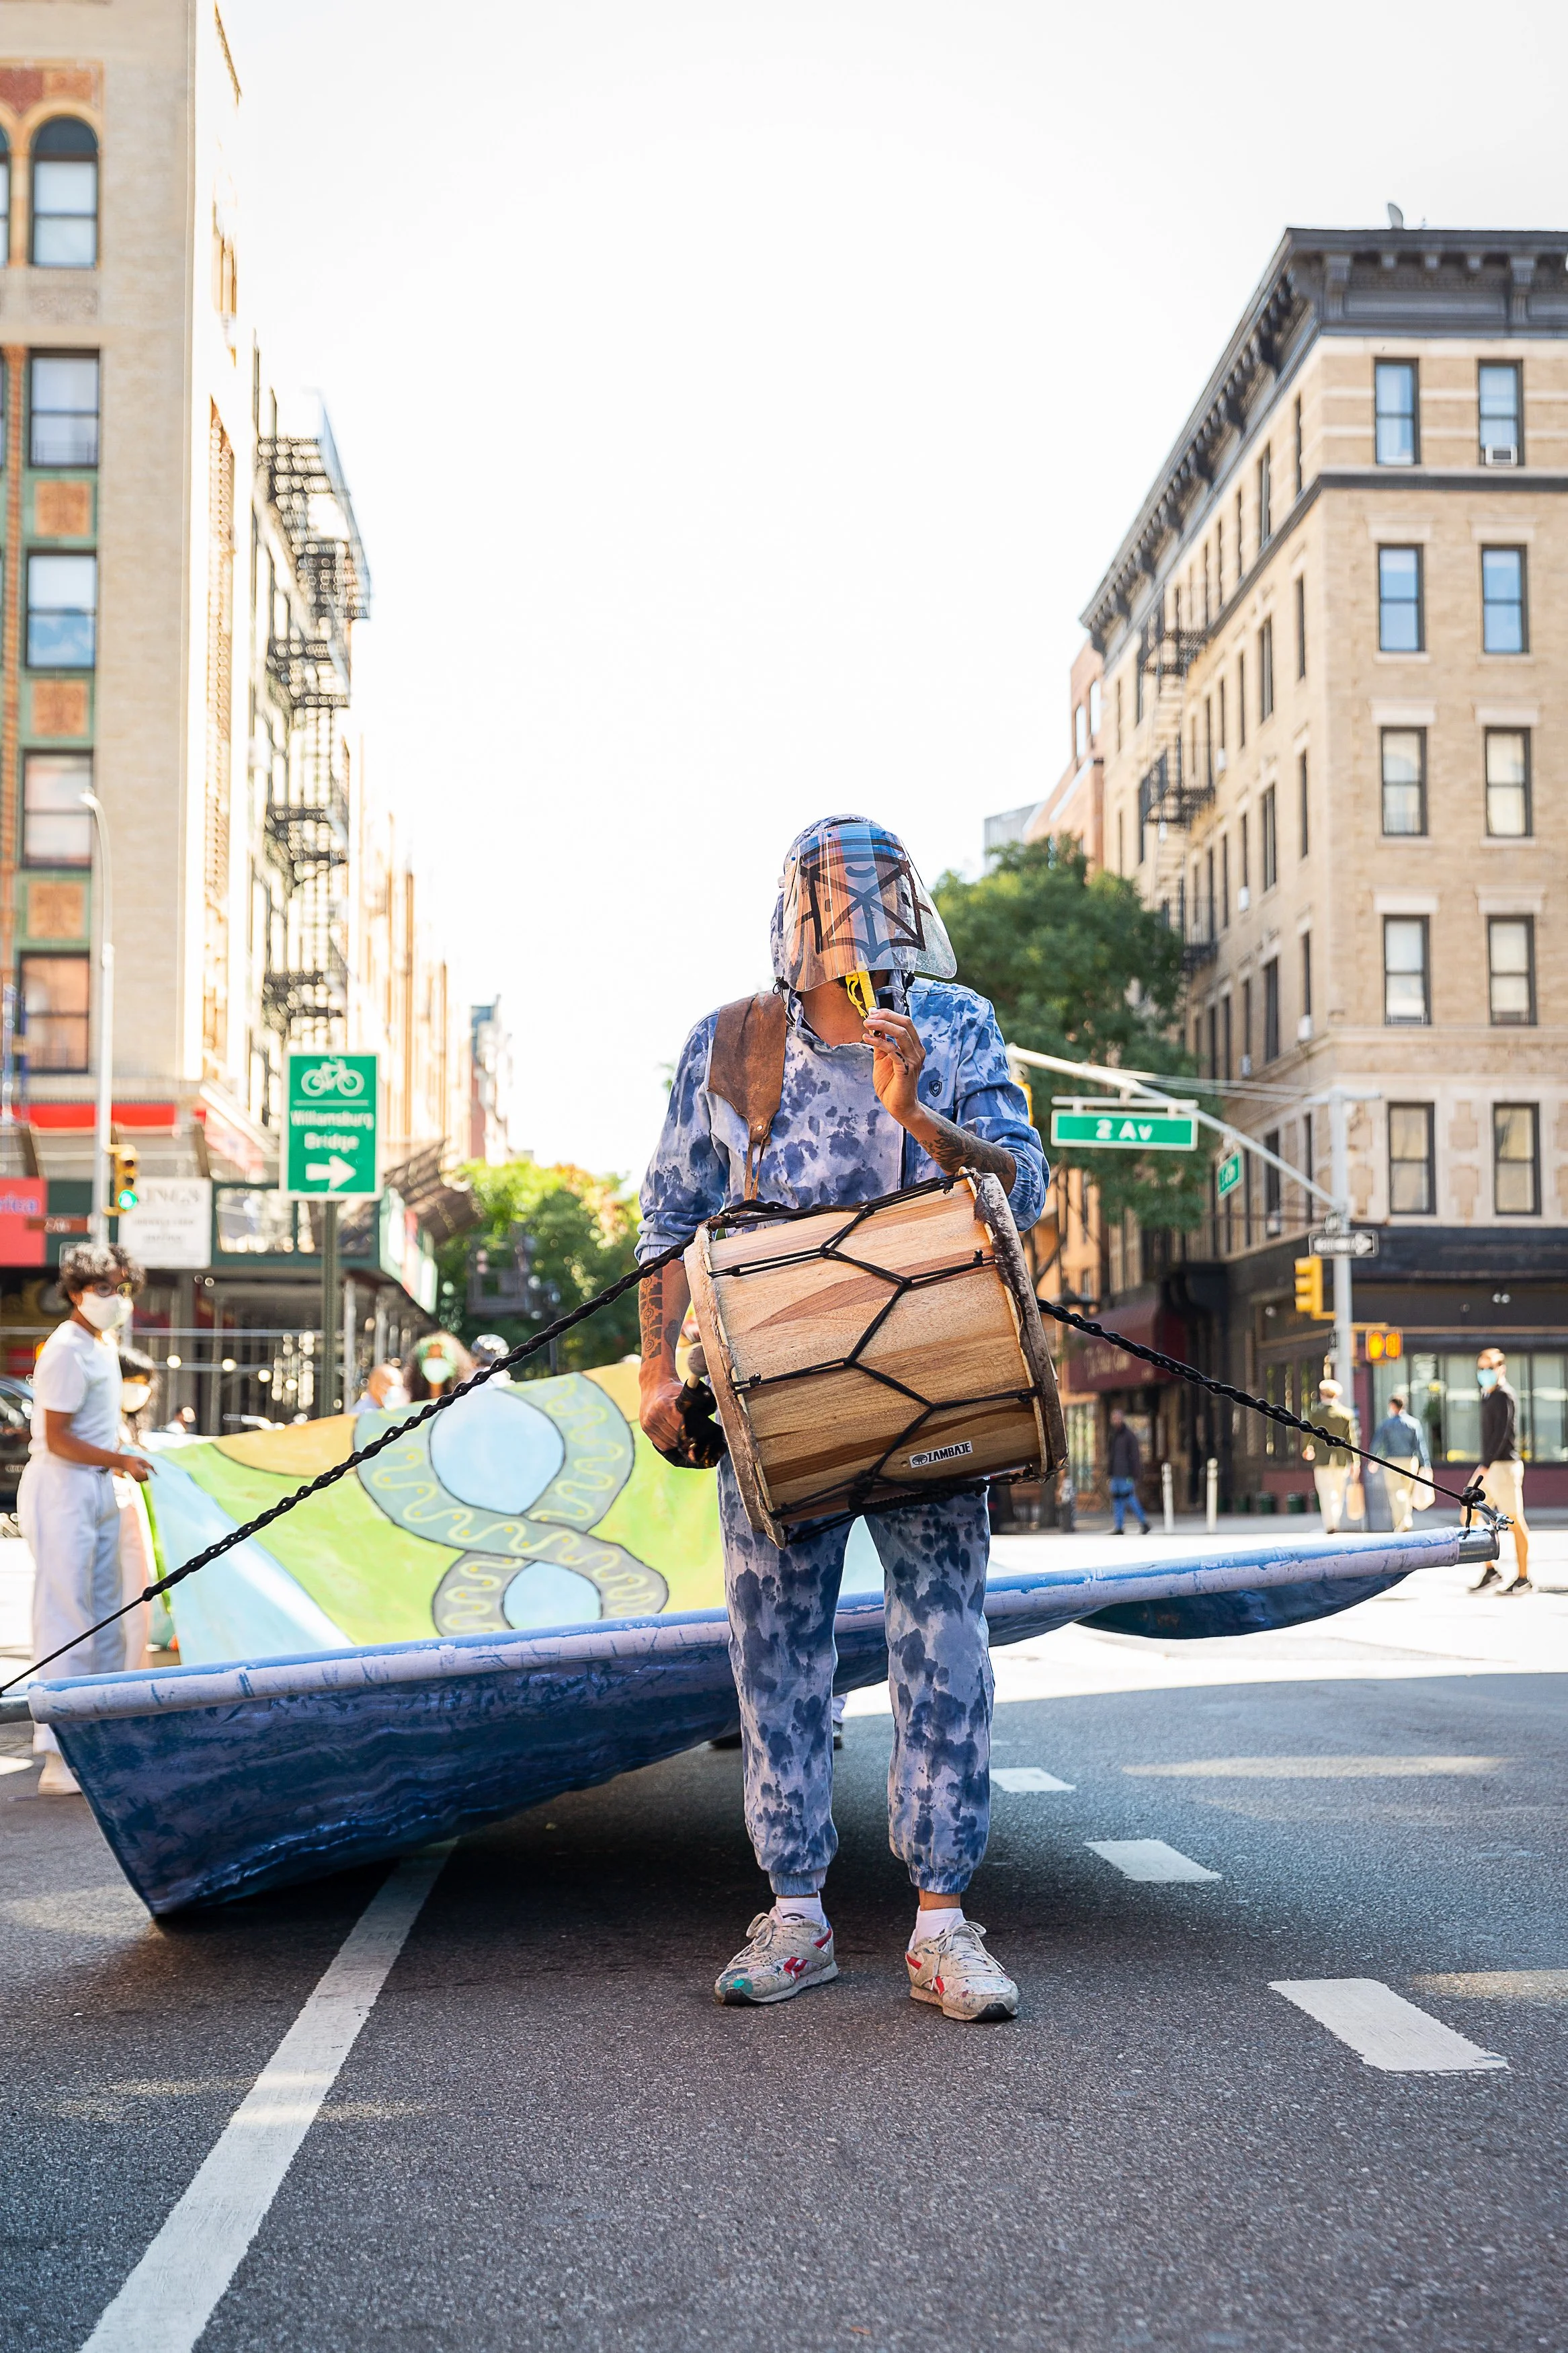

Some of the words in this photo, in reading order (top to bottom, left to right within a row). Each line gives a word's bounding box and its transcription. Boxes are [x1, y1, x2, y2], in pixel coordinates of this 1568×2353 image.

[290, 1110, 374, 1130] Williamsburg
[1096, 1119, 1113, 1140] 2
[1119, 1121, 1153, 1141] Av
[304, 1132, 360, 1154] Bridge
[927, 1442, 972, 1463] ZAMBAJE
